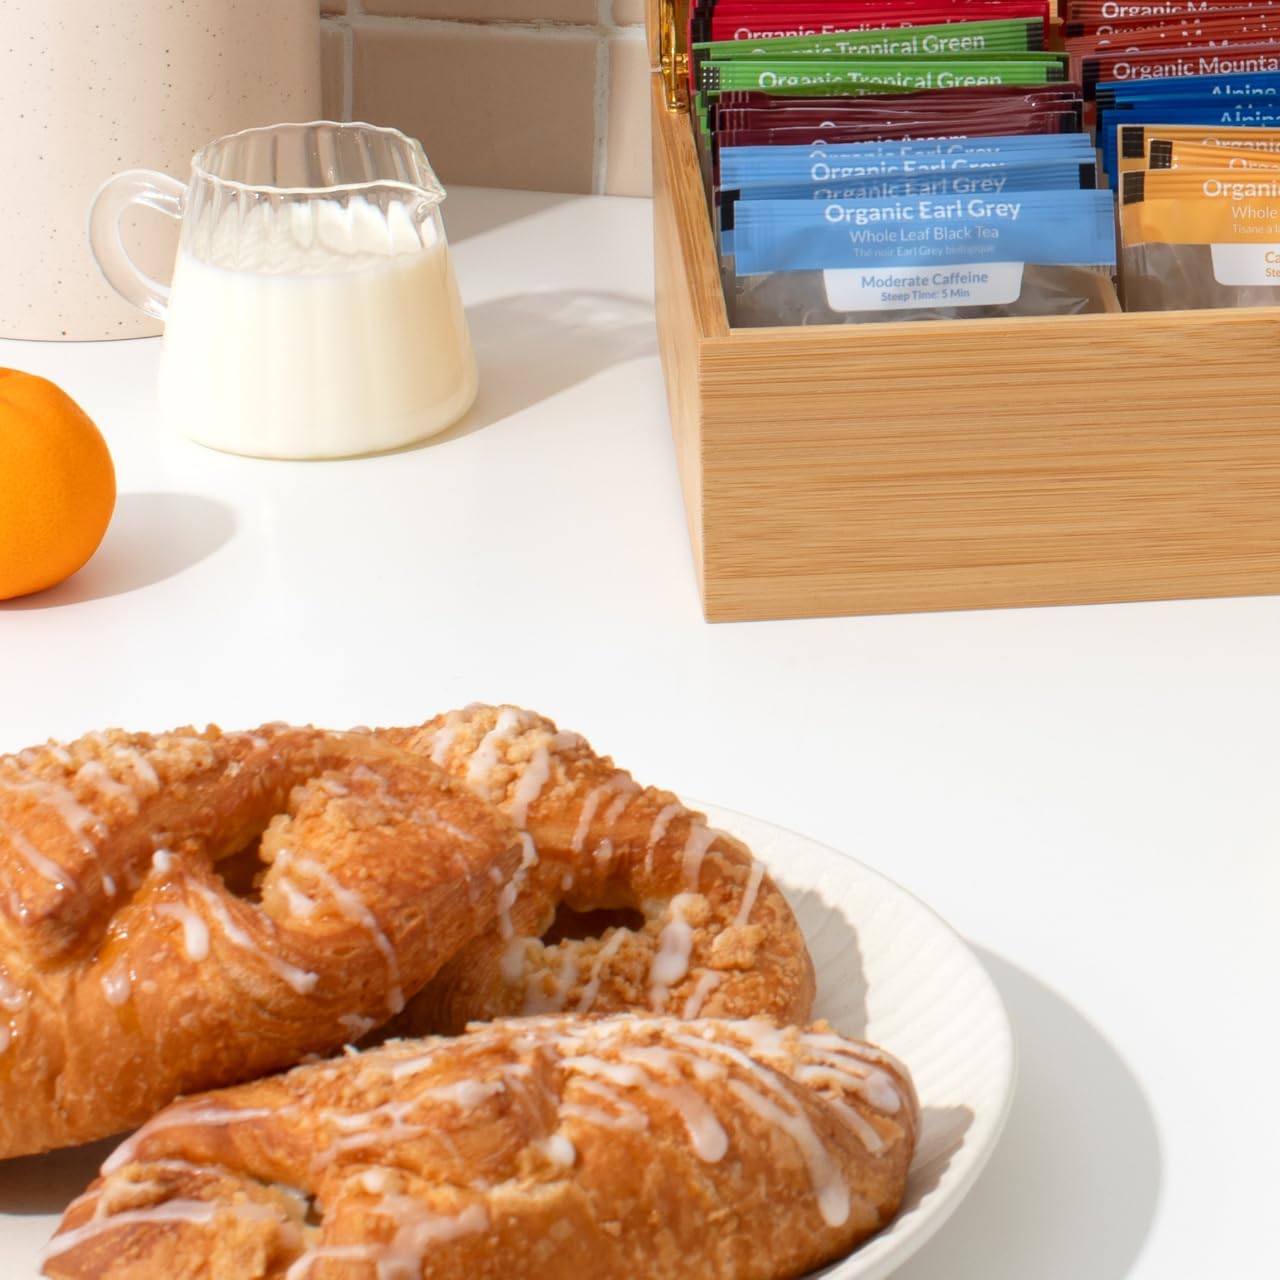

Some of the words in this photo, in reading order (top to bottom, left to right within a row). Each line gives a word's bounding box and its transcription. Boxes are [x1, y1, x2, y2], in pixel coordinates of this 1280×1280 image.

[922, 35, 986, 54] Green
[1112, 59, 1194, 80] Organic
[937, 71, 1002, 88] Green
[905, 178, 947, 196] Earl
[953, 176, 1007, 193] Grey
[825, 202, 913, 225] Organic
[919, 200, 961, 219] Earl
[968, 199, 1021, 220] Grey
[1231, 205, 1278, 219] Whole
[850, 229, 897, 243] Whole
[900, 227, 930, 241] Leaf
[934, 226, 971, 240] Black
[976, 225, 999, 239] Tea
[861, 273, 929, 289] Moderate
[932, 271, 989, 287] Caffeine
[881, 291, 910, 304] Steep
[941, 289, 949, 299] 5
[950, 288, 970, 298] Min
